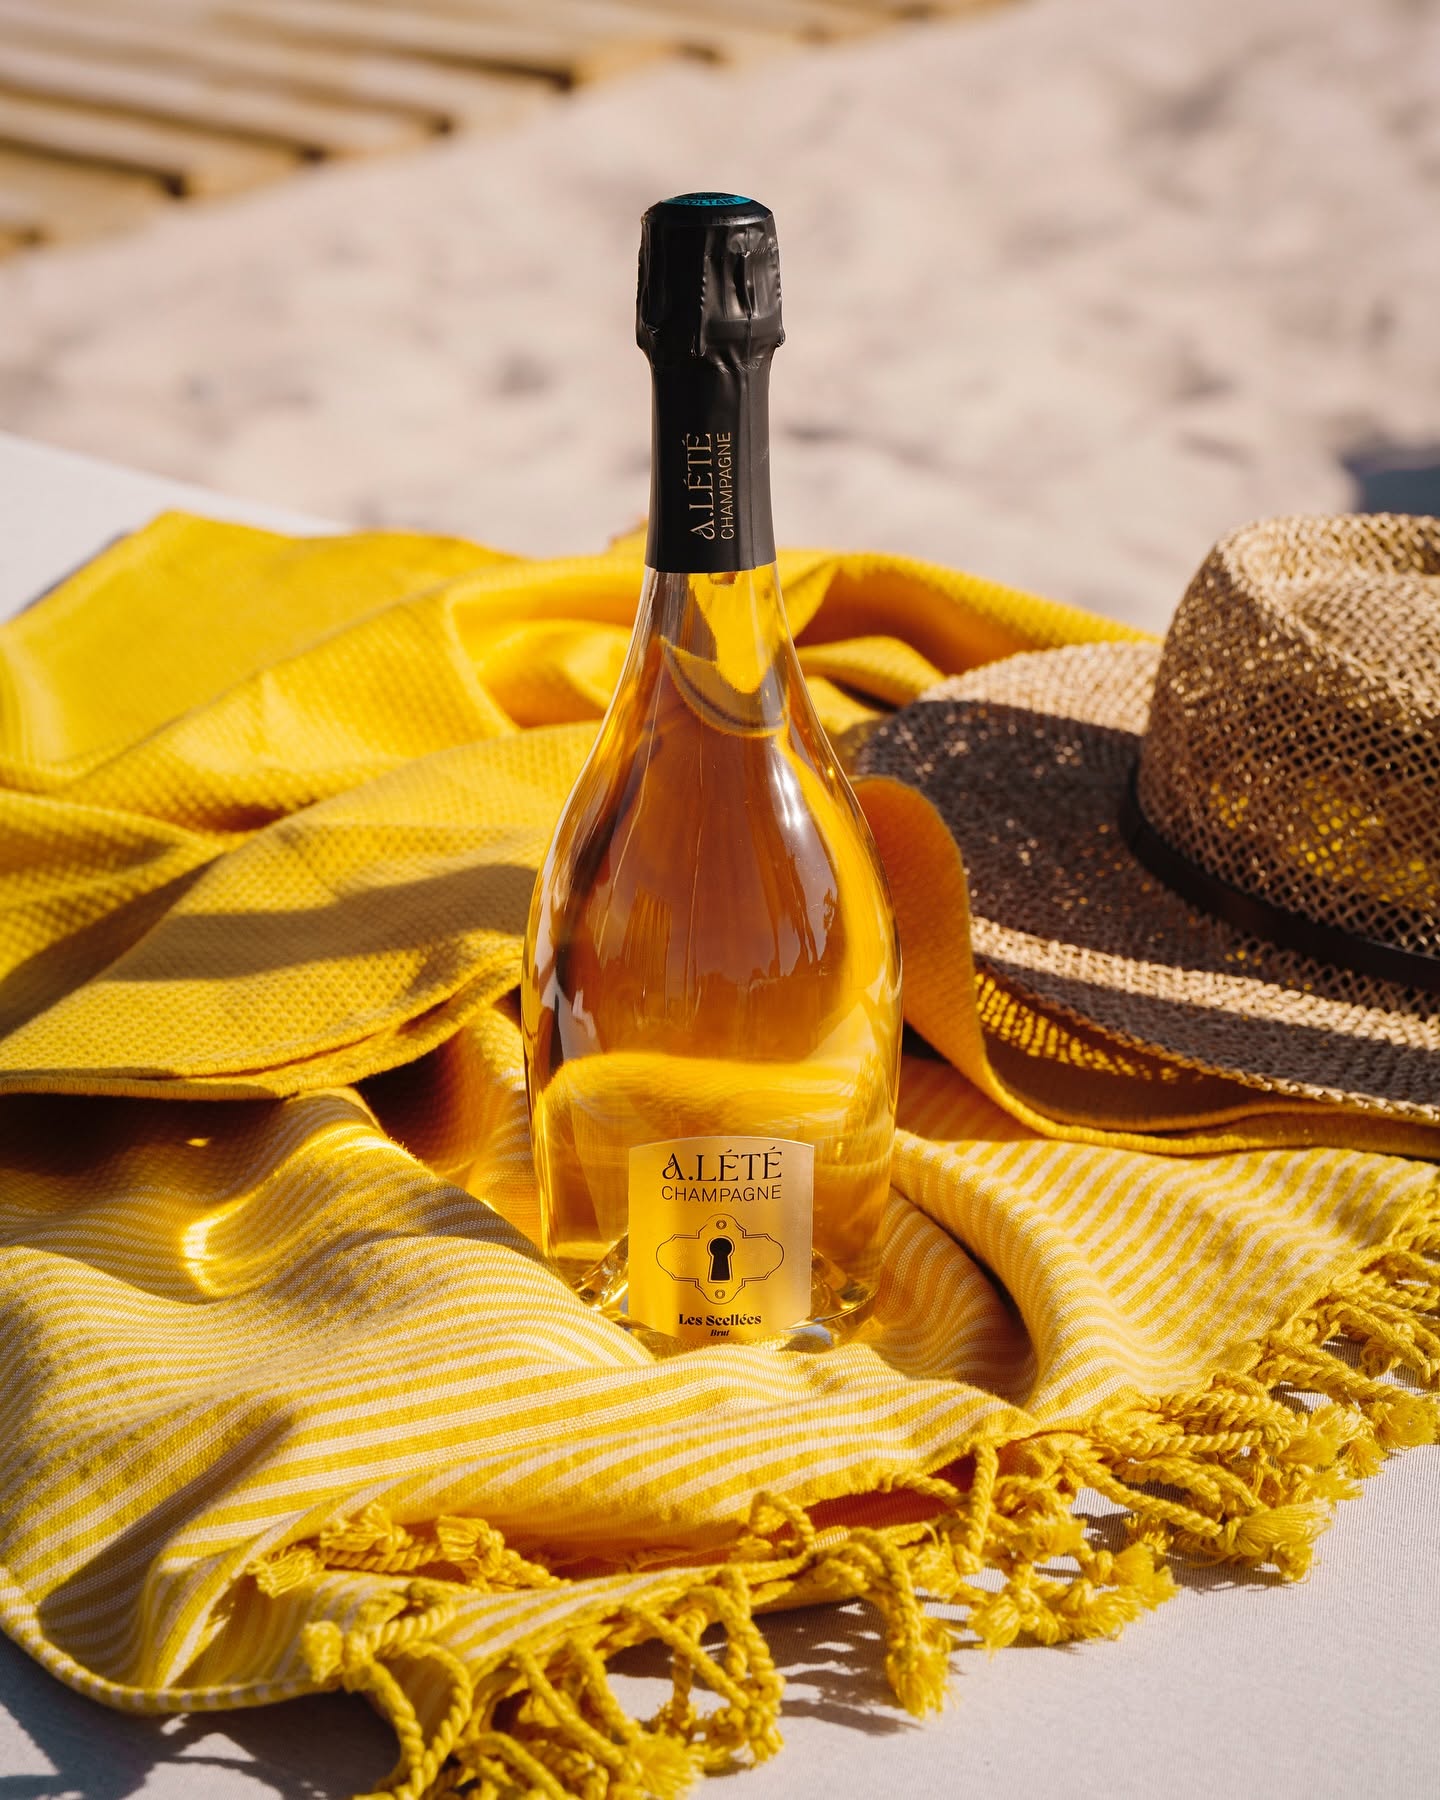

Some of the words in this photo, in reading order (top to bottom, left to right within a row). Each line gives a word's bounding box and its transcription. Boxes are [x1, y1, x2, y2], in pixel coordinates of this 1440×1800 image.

[682, 433, 716, 540] A.LÉTÉ
[717, 432, 735, 540] CHAMPAGNE
[662, 1146, 783, 1182] A.LÉTÉ
[661, 1184, 782, 1203] CHAMPAGNE
[679, 1313, 703, 1326] Les
[705, 1313, 762, 1327] Scellées
[710, 1329, 730, 1337] Brut
